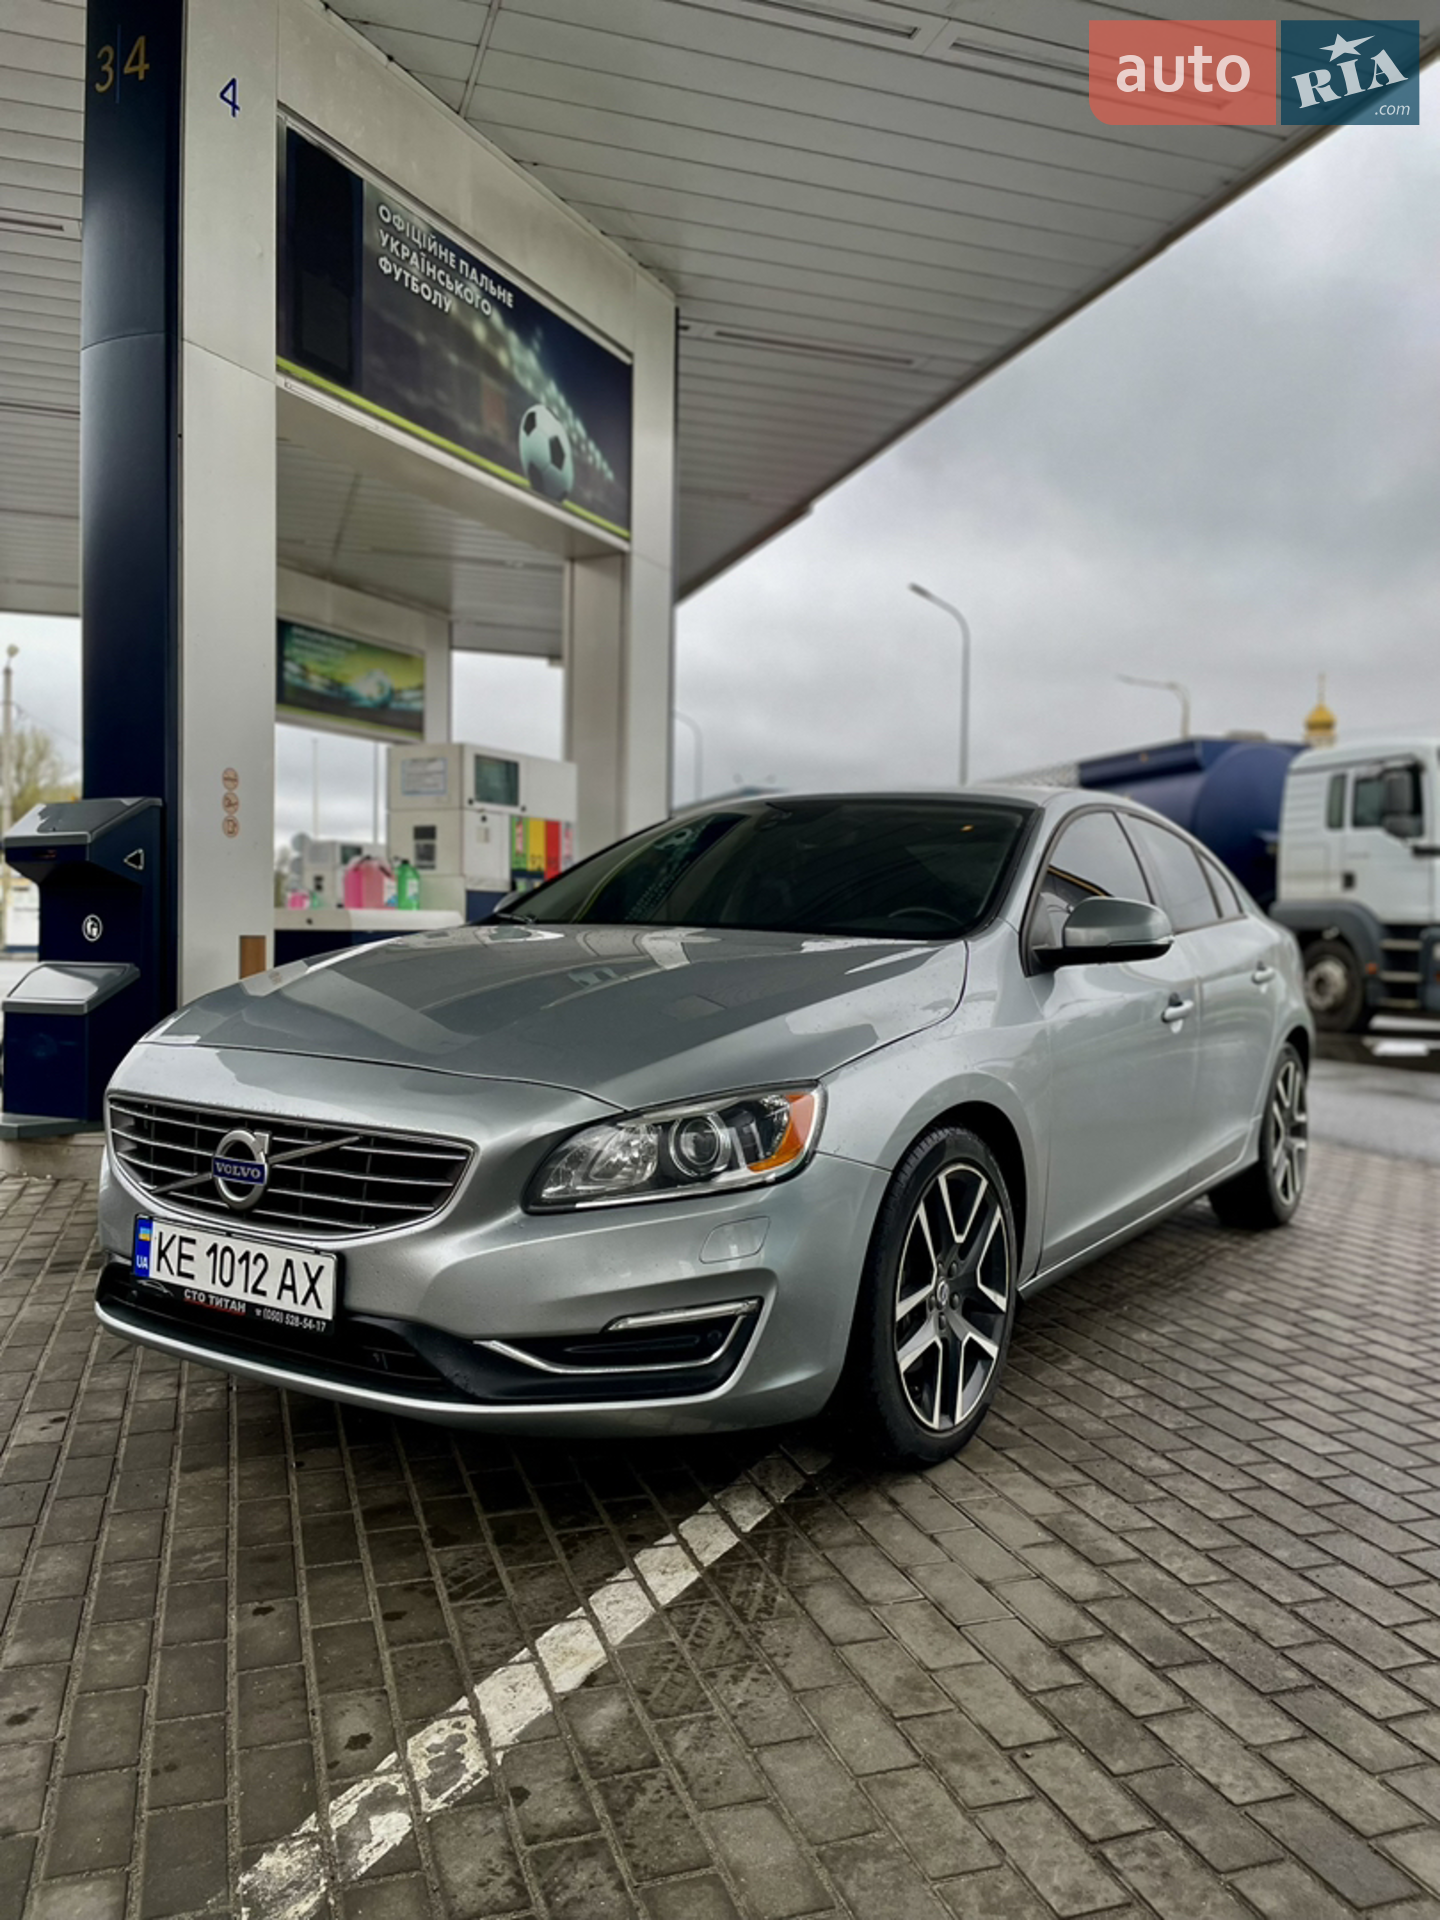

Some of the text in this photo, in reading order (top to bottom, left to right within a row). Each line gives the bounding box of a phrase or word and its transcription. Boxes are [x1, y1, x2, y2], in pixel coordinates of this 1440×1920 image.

[95, 35, 150, 93] 3 4
[219, 77, 240, 118] 4
[378, 204, 514, 308] ОФІЦІЙНЕ ПАЛЬНЕ
[378, 256, 452, 313] ФУТБОЛУ
[379, 229, 492, 316] УКРАЇНСЬКОГО
[214, 1161, 261, 1179] VOLVO
[136, 1255, 149, 1270] UA
[156, 1231, 325, 1310] KE 1012 AX
[183, 1288, 247, 1314] СТО ТИТАН
